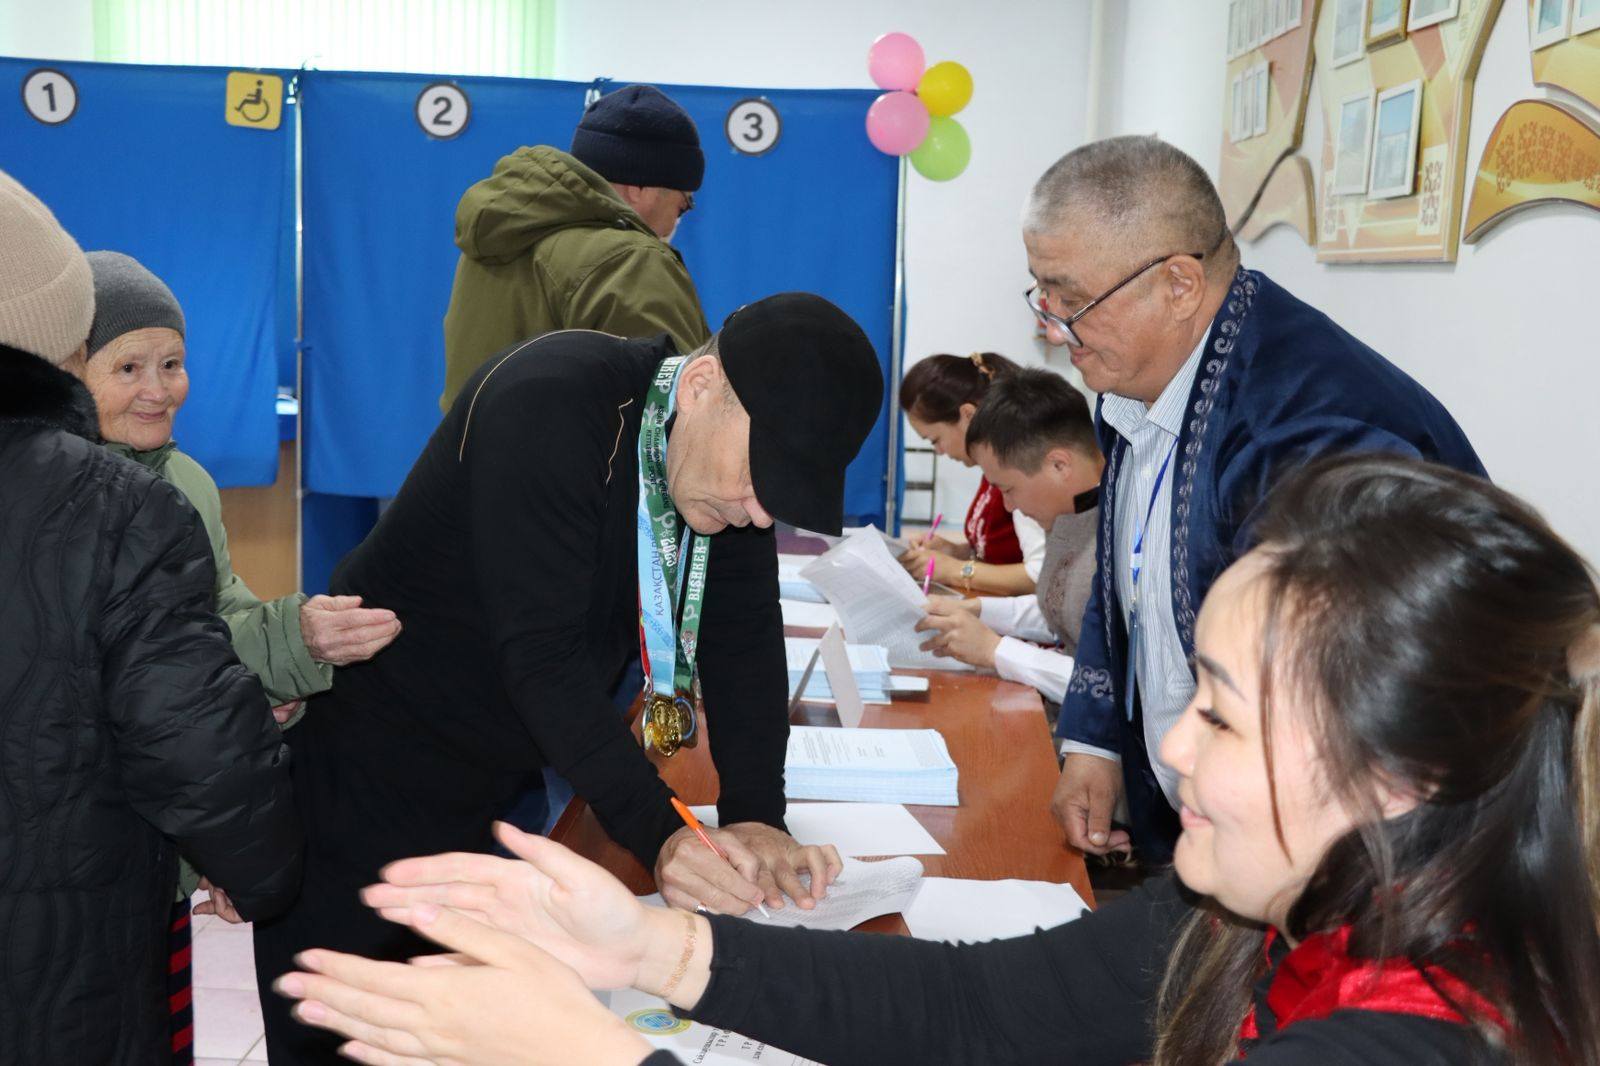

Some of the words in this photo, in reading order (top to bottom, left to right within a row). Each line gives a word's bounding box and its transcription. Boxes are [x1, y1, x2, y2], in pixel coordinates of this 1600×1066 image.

[42, 82, 57, 112] 1
[432, 96, 453, 126] 2
[743, 112, 764, 142] 3
[648, 465, 656, 486] SPORT
[660, 537, 678, 567] 2023
[688, 545, 708, 601] BISHKEK
